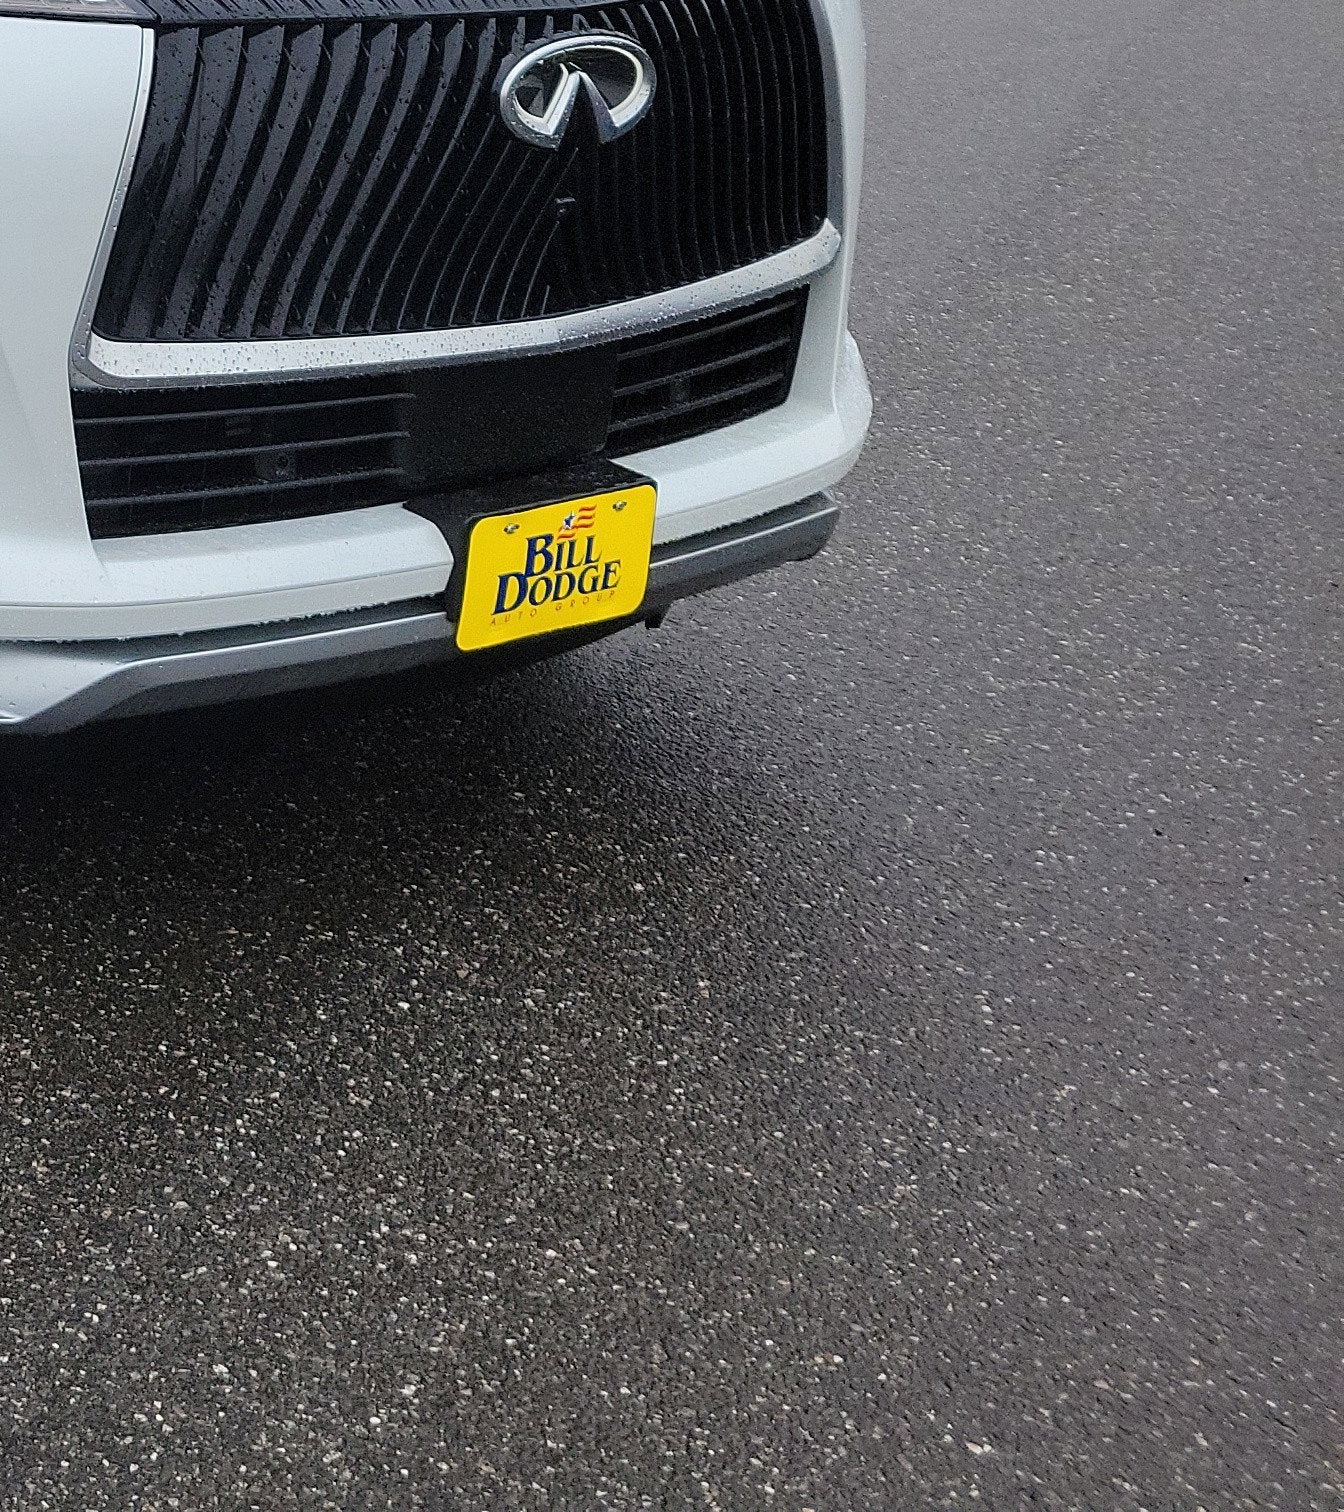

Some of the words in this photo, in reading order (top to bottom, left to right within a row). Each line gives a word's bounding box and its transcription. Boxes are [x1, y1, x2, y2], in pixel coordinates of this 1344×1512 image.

[524, 533, 602, 578] BILL
[490, 607, 538, 626] AUTO
[555, 590, 616, 612] GROUP
[491, 558, 621, 616] DODGE
